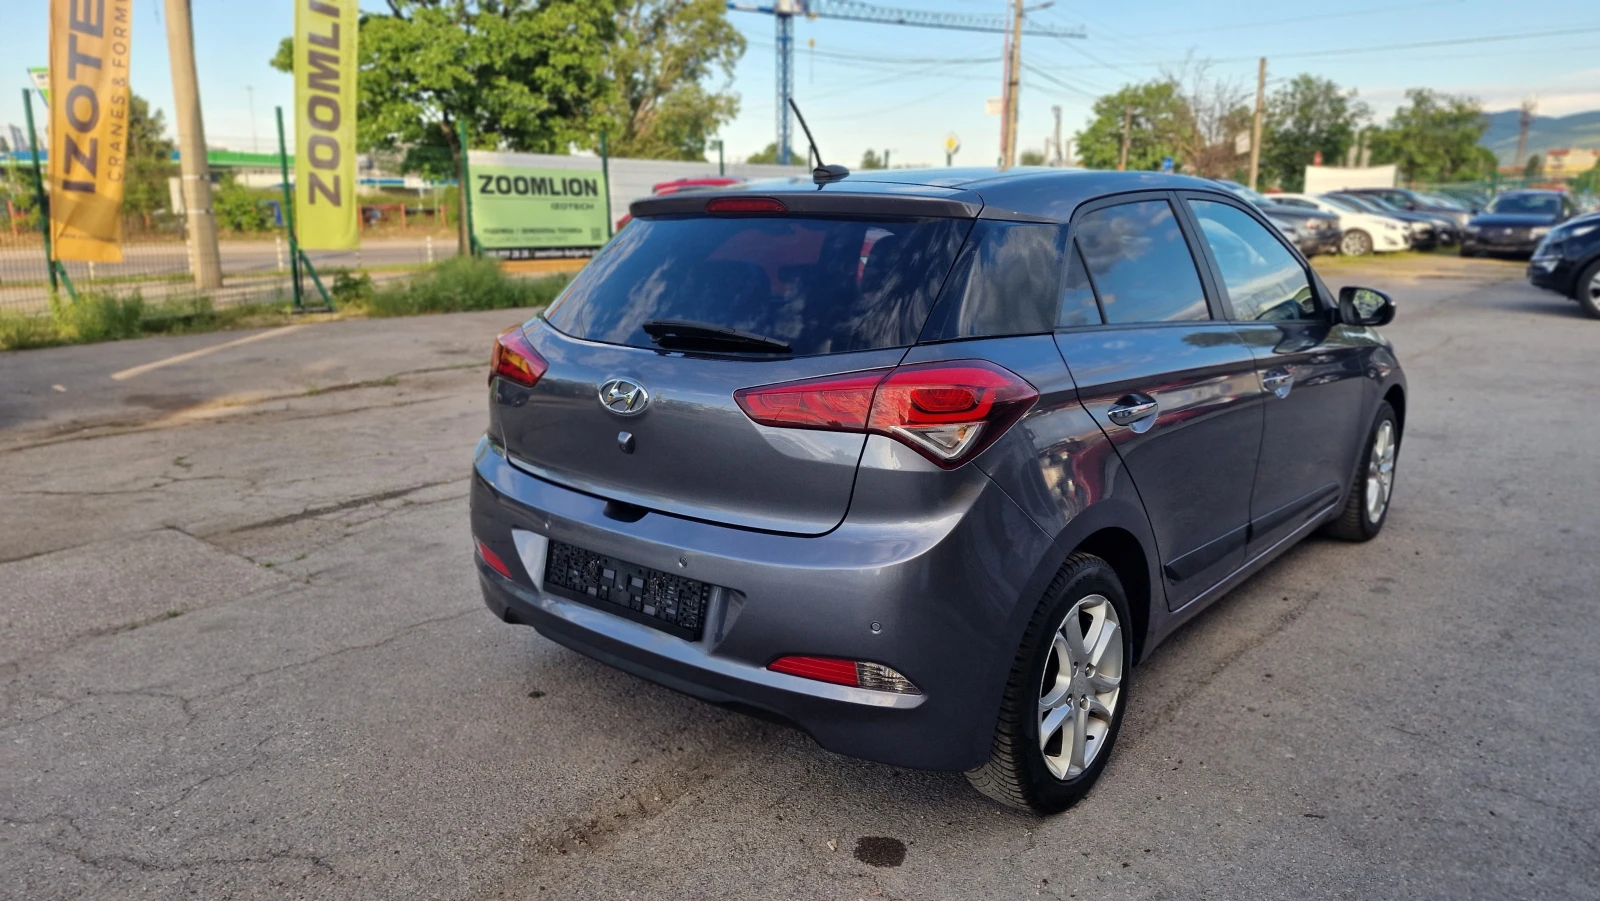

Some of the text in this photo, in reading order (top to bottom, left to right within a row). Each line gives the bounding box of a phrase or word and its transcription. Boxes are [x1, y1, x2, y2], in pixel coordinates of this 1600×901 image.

[112, 0, 130, 67] FORM
[107, 94, 127, 184] CRANES
[307, 0, 342, 208] ZOOMLI
[478, 175, 598, 197] ZOOMLION
